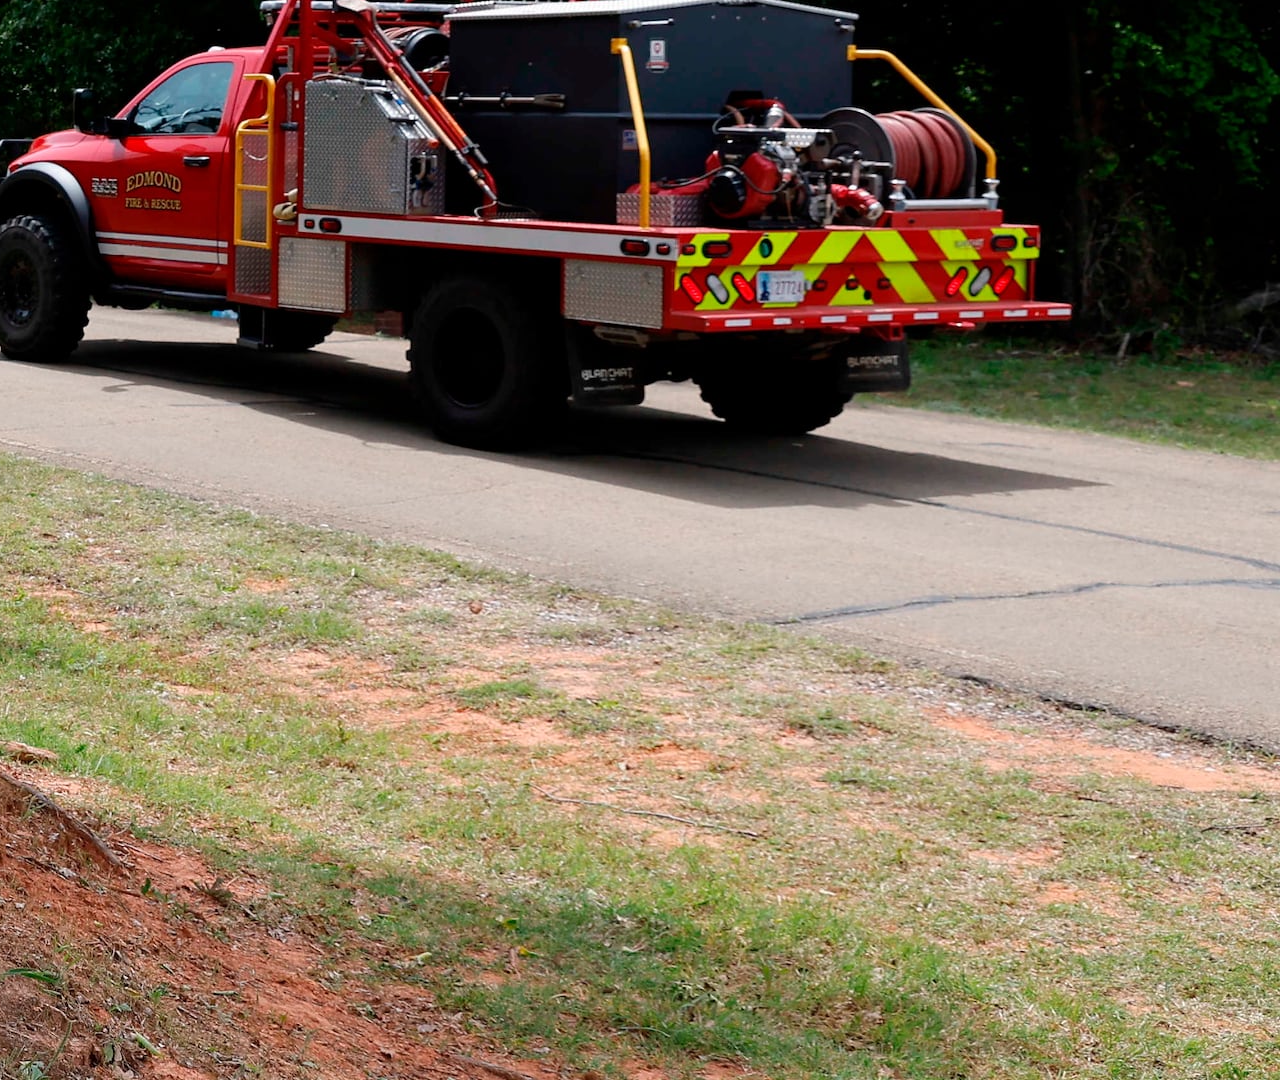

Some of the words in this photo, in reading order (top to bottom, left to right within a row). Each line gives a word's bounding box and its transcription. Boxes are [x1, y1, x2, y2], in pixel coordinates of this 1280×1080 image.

[125, 170, 182, 193] EDMOND
[125, 197, 143, 208] FIRE
[151, 199, 182, 210] RESCUE
